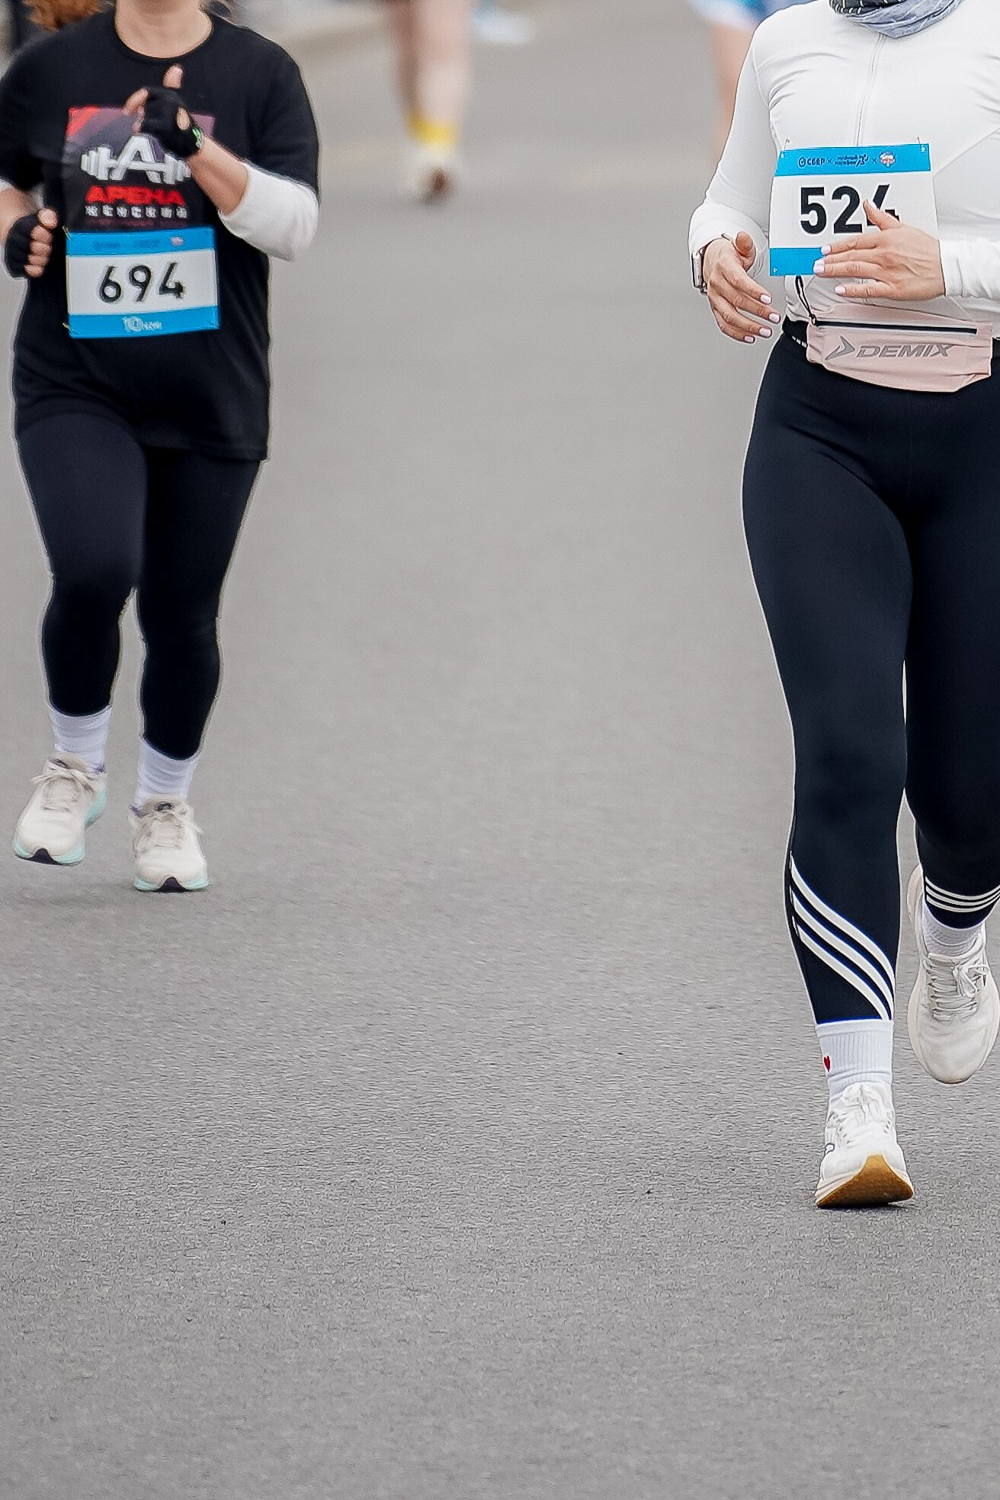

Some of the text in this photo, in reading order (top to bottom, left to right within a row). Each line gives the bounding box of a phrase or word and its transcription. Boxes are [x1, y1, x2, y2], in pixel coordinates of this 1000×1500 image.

[800, 184, 900, 235] 524
[98, 261, 184, 304] 694
[856, 344, 953, 358] DEMIX
